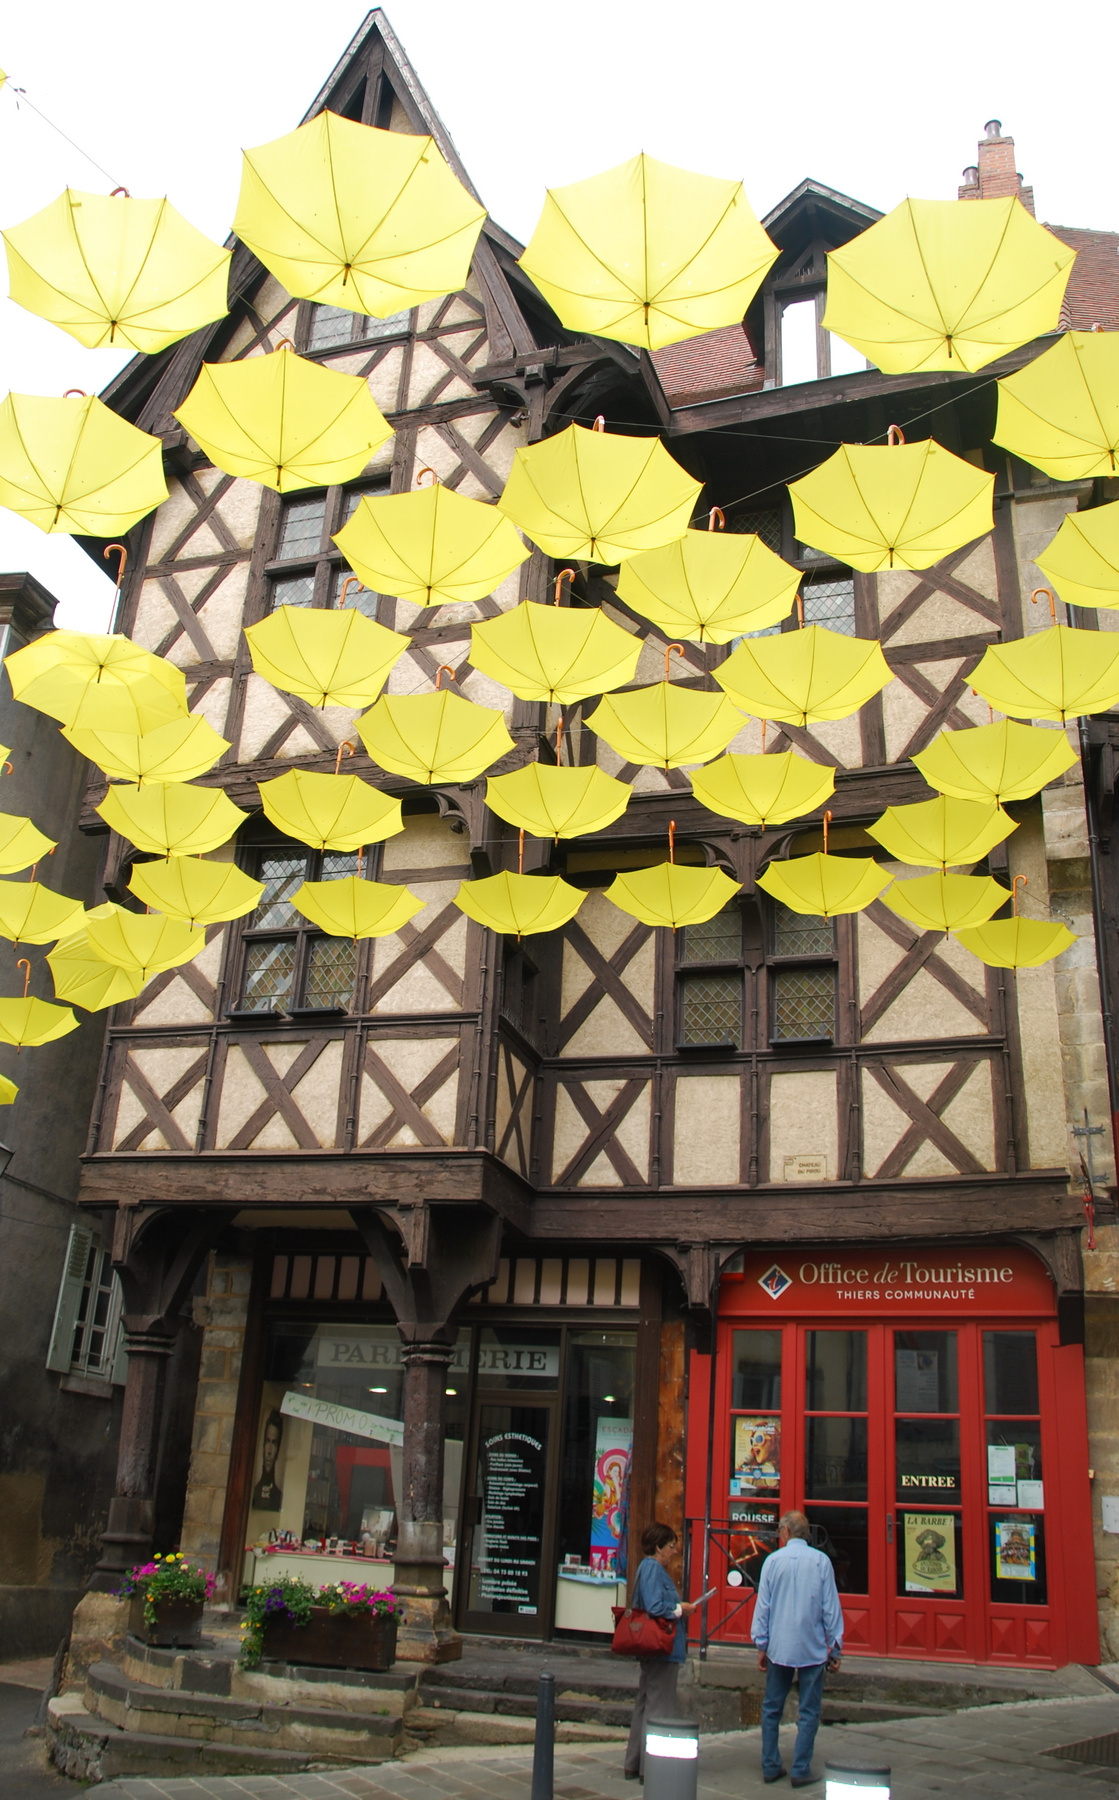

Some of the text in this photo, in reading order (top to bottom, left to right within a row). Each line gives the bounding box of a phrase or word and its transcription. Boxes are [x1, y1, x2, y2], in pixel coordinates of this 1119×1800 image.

[800, 1262, 1013, 1285] Office de Tourisme
[836, 1288, 975, 1300] THIERS COMMUNAUTÉ
[485, 1432, 542, 1451] SOINS ESTHETIQUES
[901, 1475, 956, 1488] ENTREE
[732, 1512, 775, 1523] ROUSSE
[907, 1516, 918, 1525] LA
[920, 1516, 947, 1527] BARBE
